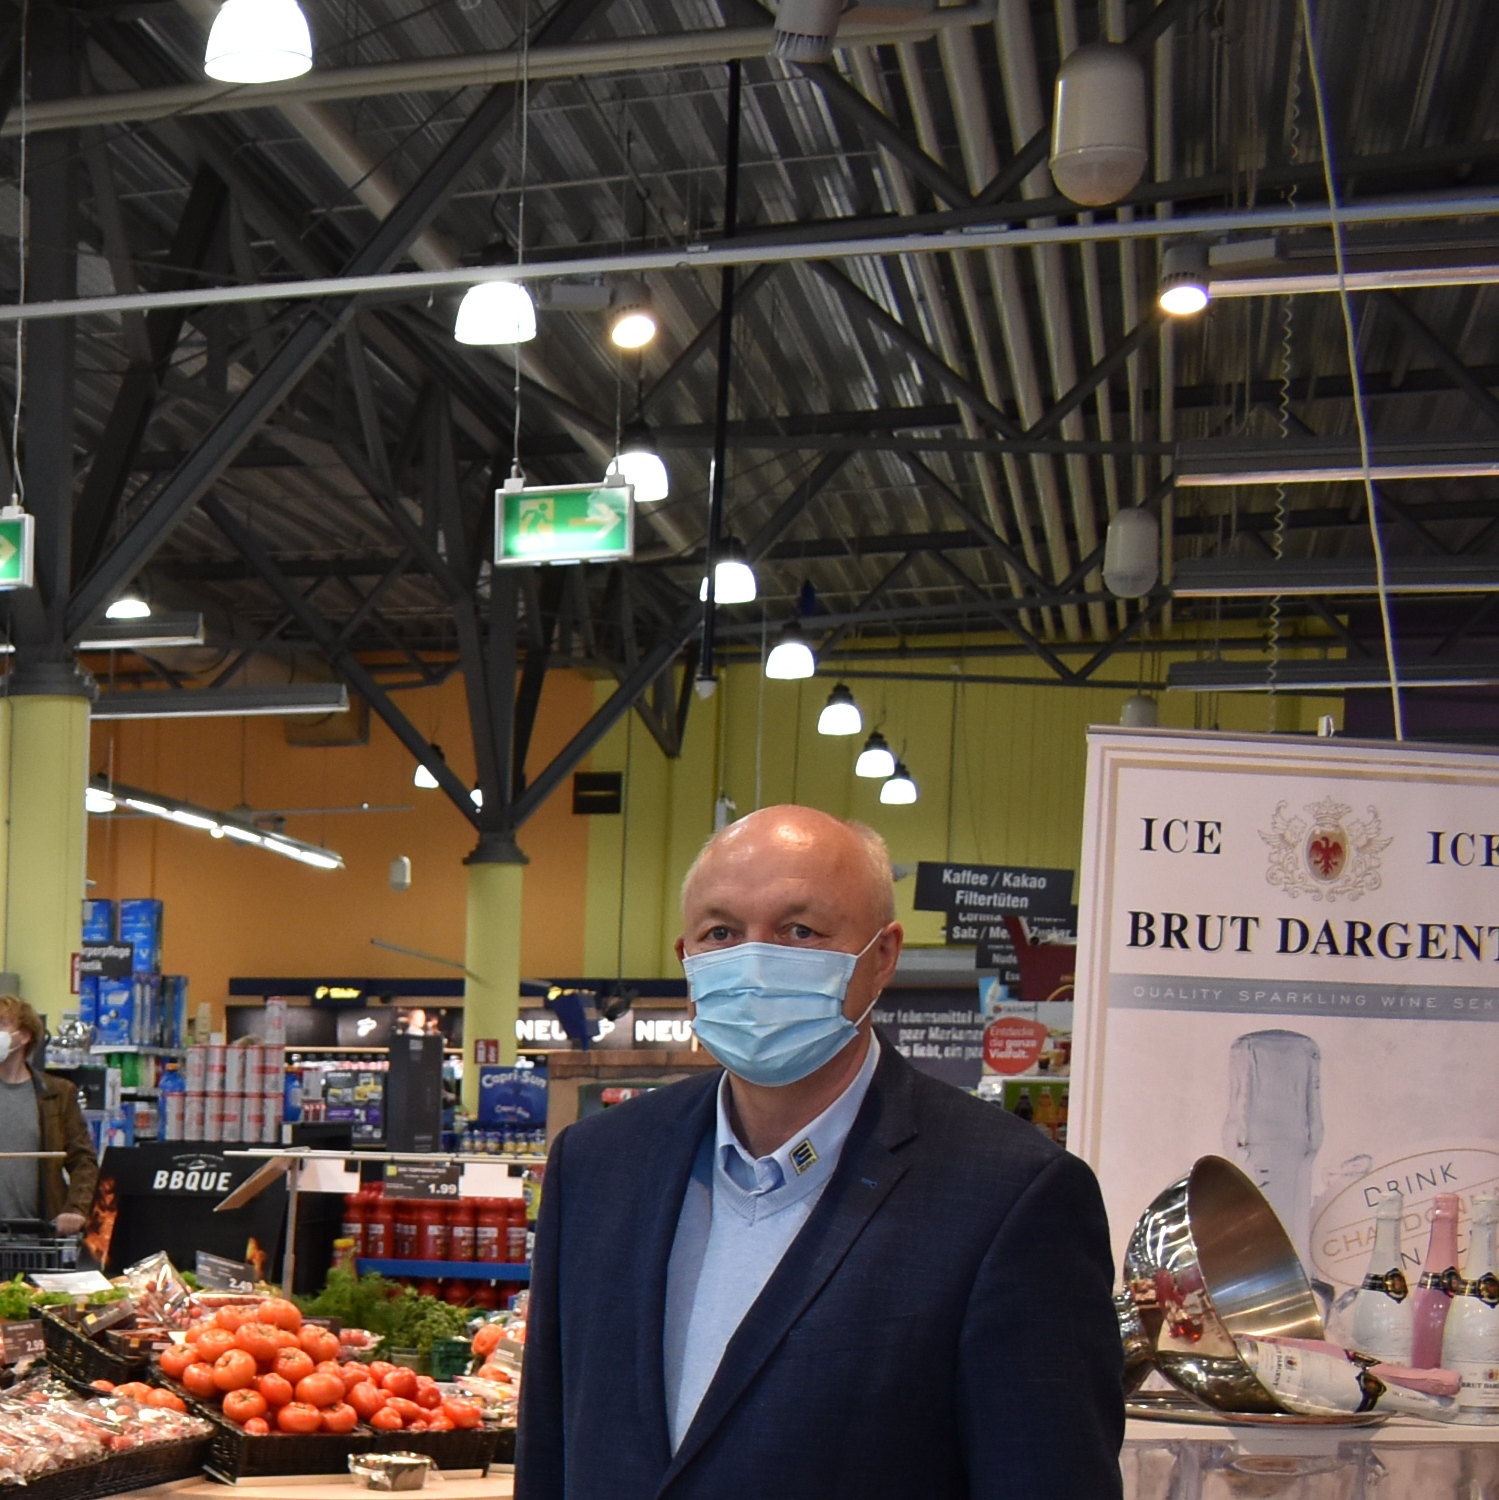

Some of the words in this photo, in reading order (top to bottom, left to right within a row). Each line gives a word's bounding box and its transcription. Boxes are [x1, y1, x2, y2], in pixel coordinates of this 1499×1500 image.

[1139, 817, 1222, 855] ICE
[1426, 831, 1499, 867] ICE
[942, 868, 988, 887] Kaffee
[1002, 872, 1046, 890] Kakao
[955, 889, 1029, 909] Filtertüten
[989, 926, 1011, 940] Me
[1126, 911, 1260, 953] BRUT
[1133, 986, 1223, 1001] QUALITY
[1239, 991, 1367, 1006] SPARKLING
[1381, 996, 1438, 1009] WINE
[1452, 998, 1499, 1010] SEK
[635, 1020, 692, 1042] NEU
[153, 1170, 232, 1191] BBQUE
[428, 1183, 457, 1194] 1.99
[1364, 1162, 1457, 1207] DRINK
